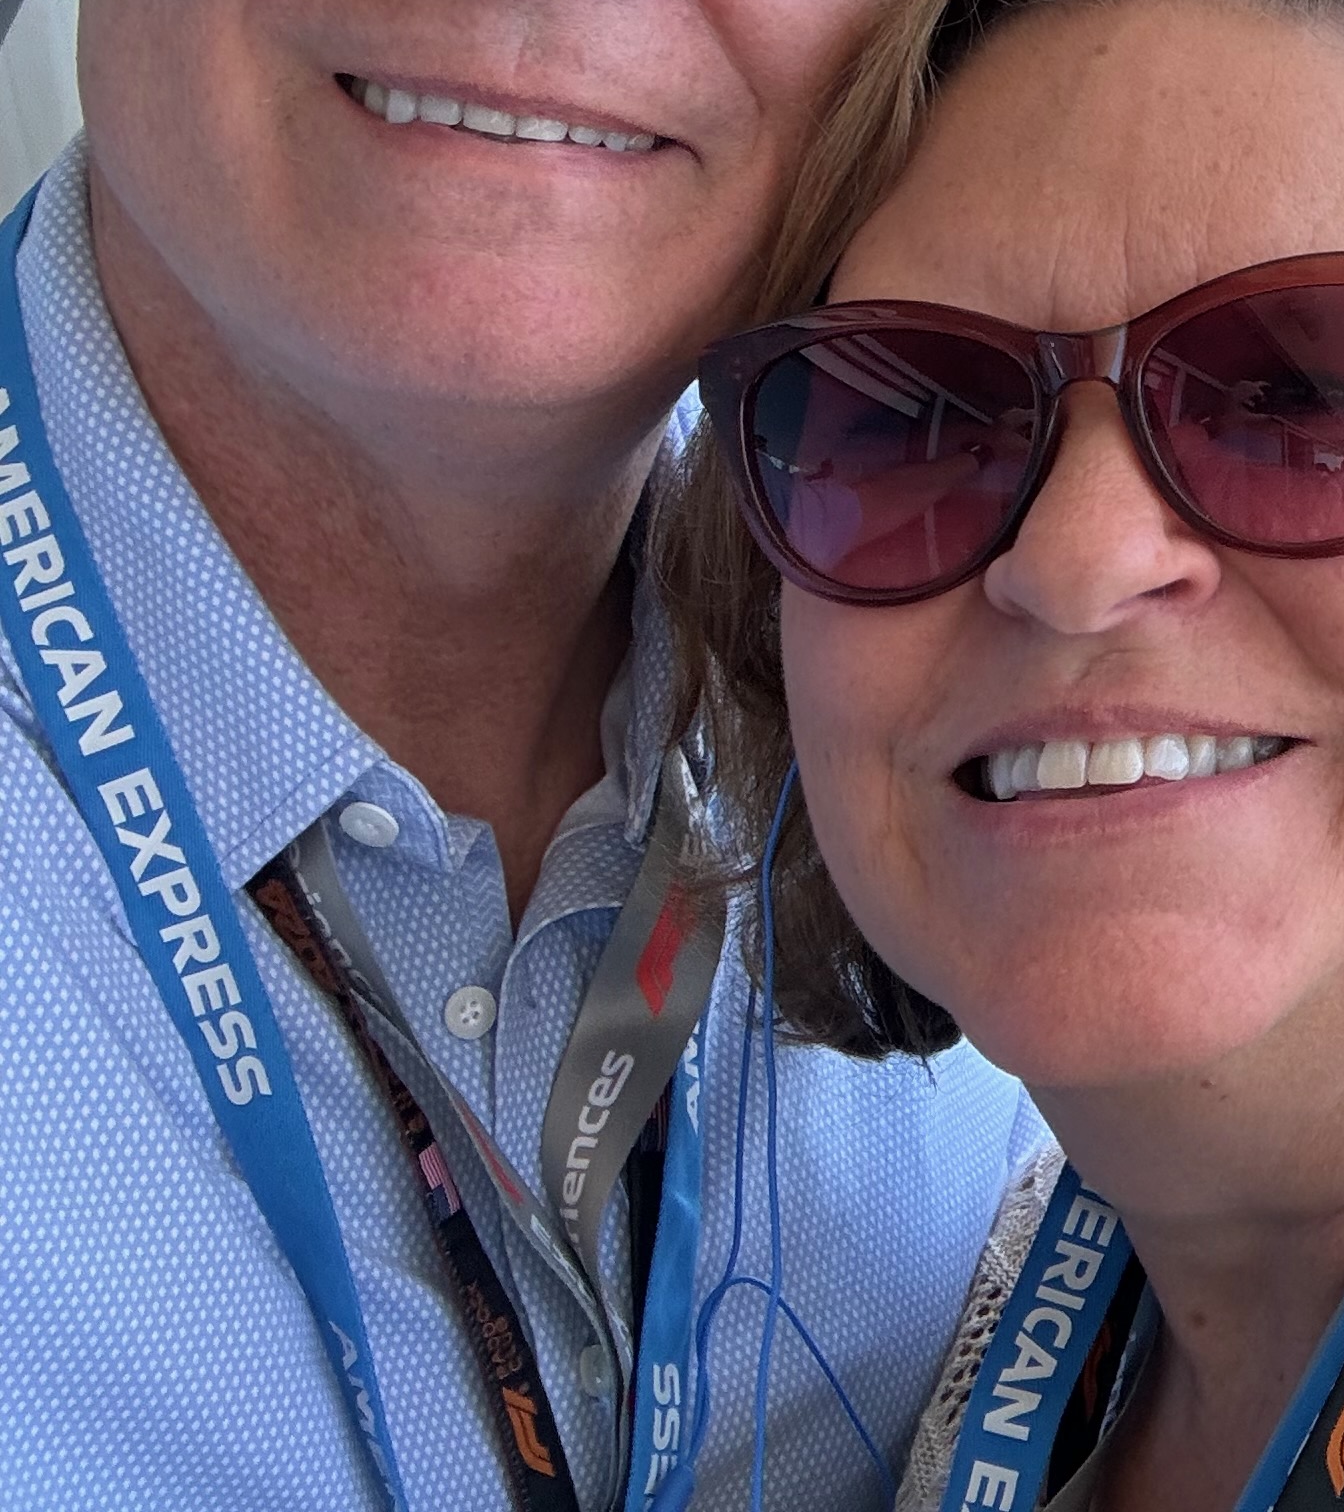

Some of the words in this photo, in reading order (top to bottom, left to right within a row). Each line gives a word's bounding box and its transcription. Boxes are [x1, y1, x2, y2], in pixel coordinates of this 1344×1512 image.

[0, 391, 136, 757] MERICAN
[97, 767, 273, 1107] EXPRESS
[982, 1190, 1121, 1442] ERICAN
